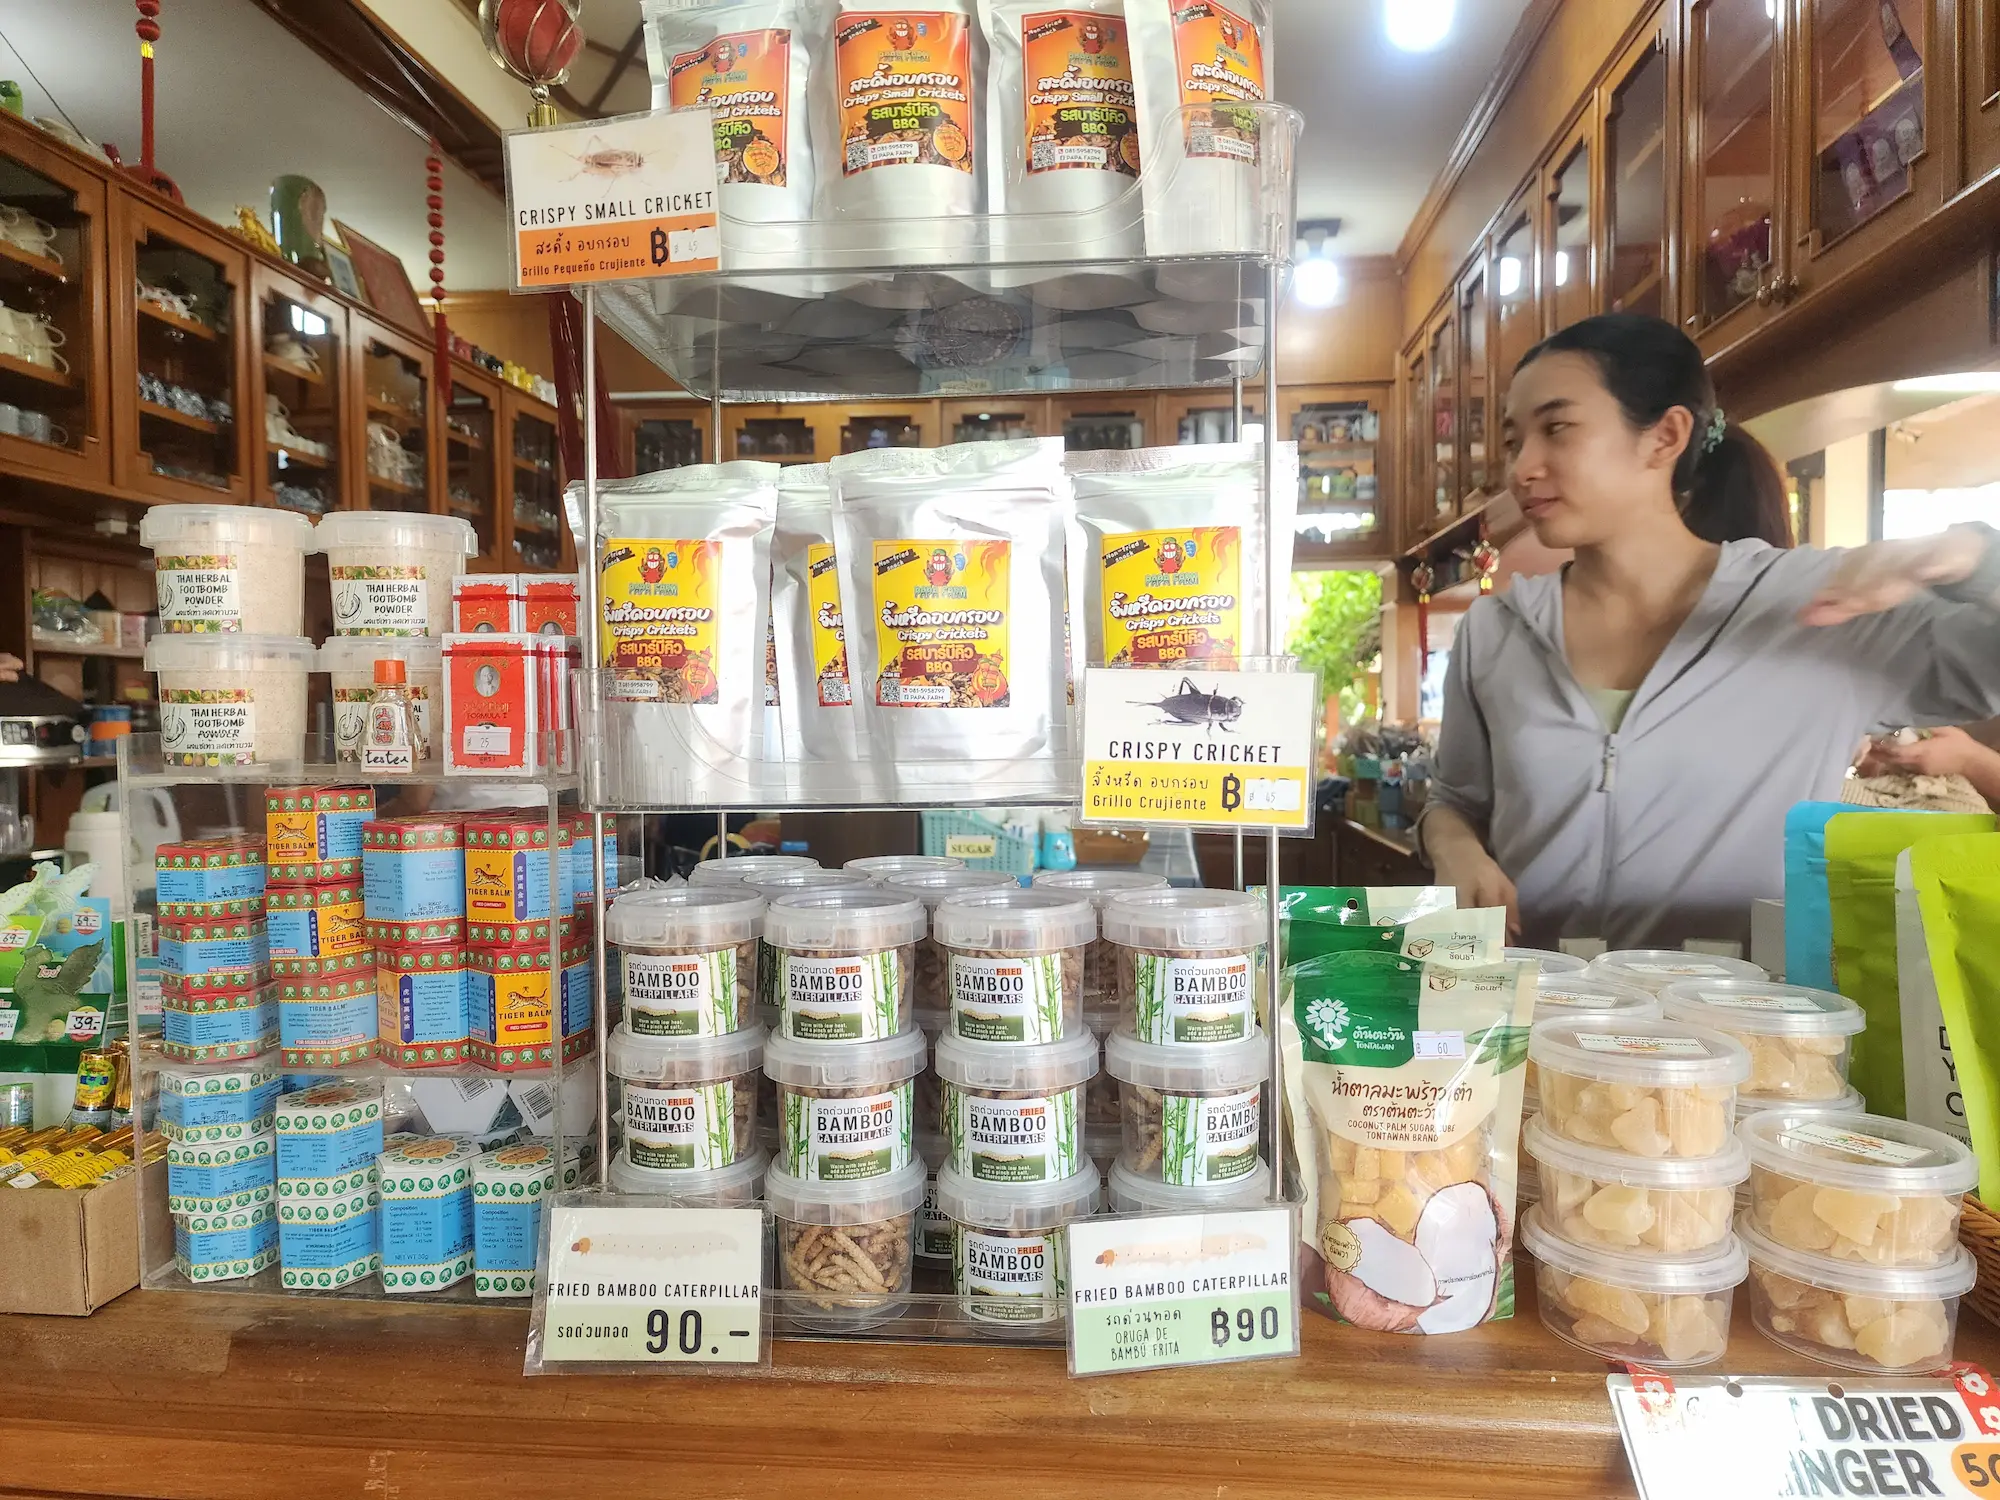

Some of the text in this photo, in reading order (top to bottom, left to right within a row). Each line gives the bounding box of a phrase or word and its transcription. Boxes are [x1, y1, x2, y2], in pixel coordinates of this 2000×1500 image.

[1185, 79, 1220, 94] Crispy
[1222, 84, 1244, 100] Small
[843, 88, 966, 108] Crispy Small Crickets
[1030, 91, 1103, 105] Crispy Small
[732, 106, 781, 116] Crickets
[871, 103, 939, 119] รสบาร์บีคิว
[1060, 108, 1127, 124] รสบาร์บีคิว
[893, 118, 920, 129] BBQ
[1081, 123, 1107, 135] BBQ
[520, 192, 712, 226] CRISPY SMALL CRICKET
[535, 232, 630, 255] สะดิ้ง อบกรอบ
[522, 258, 646, 277] Grillo Pequeño Crujiente
[177, 574, 231, 583] THAI HERBAL
[180, 585, 228, 594] FOOTBOMB
[366, 584, 420, 593] THAI HERBAL
[185, 595, 224, 605] POWDER
[369, 595, 416, 603] FOOTBOMB
[374, 605, 413, 614] POWDER
[1125, 613, 1220, 630] Crispy Crickets
[613, 624, 697, 638] Crispy Crickets
[898, 627, 987, 644] Crispy Crickets
[1137, 629, 1207, 649] รสบาร์บีคิว
[620, 640, 682, 654] รสบาร์บีคิว
[907, 644, 974, 660] รสบาร์บีคิว
[1159, 648, 1186, 660] BBQ
[637, 656, 662, 667] BBQ
[926, 662, 953, 673] BBQ
[190, 708, 248, 717] THAI HERBAL
[194, 719, 245, 727] FOOTBOMB
[198, 730, 240, 739] POWDER
[481, 738, 489, 748] 25
[1109, 741, 1281, 763] CRISPY CRICKET
[1092, 766, 1208, 790] จิ้งหรีด อบกรอบ
[1093, 795, 1207, 811] Grillo Crujiente
[951, 843, 992, 854] SUGAR
[321, 934, 346, 944] TIGER
[835, 966, 861, 974] FRIED
[1227, 964, 1245, 974] FRIED
[629, 971, 699, 987] BAMBOO
[791, 974, 862, 990] BAMBOO
[956, 972, 1023, 991] BAMBOO
[1175, 973, 1246, 992] BAMBOO
[630, 987, 698, 999] CATERPILLARS
[791, 990, 861, 1002] CATERPILLARS
[956, 989, 1023, 1004] CATERPILLARS
[1174, 990, 1245, 1004] CATERPILLARS
[73, 1016, 100, 1030] 39.-
[1353, 1026, 1405, 1040] ต้นตะวัน
[1438, 1042, 1448, 1054] 60
[668, 1098, 693, 1106] FRIED
[871, 1100, 892, 1112] FRIED
[628, 1102, 694, 1121] BAMBOO
[1020, 1107, 1045, 1116] FRIED
[1207, 1105, 1259, 1130] BAMBO
[628, 1117, 694, 1132] CATERPILLARS
[818, 1109, 892, 1131] BAMBOO
[971, 1114, 1045, 1132] BAMBOO
[1348, 1120, 1455, 1133] COCONUT PALM SUGAR UBE
[818, 1125, 892, 1143] CATERPILLARS
[971, 1130, 1045, 1144] CATERPILLARS
[1367, 1132, 1438, 1142] TONTAWAN BRAND
[1018, 1245, 1043, 1254] FRIED
[969, 1248, 1044, 1270] BAMBOO
[970, 1265, 1043, 1282] CATERPILLARS
[548, 1283, 759, 1298] FRIED BAMBOO CATERPILLAR
[1075, 1272, 1288, 1303] FRIED BAMBOO CATERPILLAR
[1106, 1308, 1182, 1326] รถด่วนทอด
[557, 1322, 629, 1339] รถด่วนทอด
[1115, 1327, 1168, 1344] ORUGA DE
[1111, 1341, 1180, 1361] BAMBÚ FRITA
[1811, 1396, 1964, 1441] DRIED
[1789, 1449, 1943, 1496] INGER
